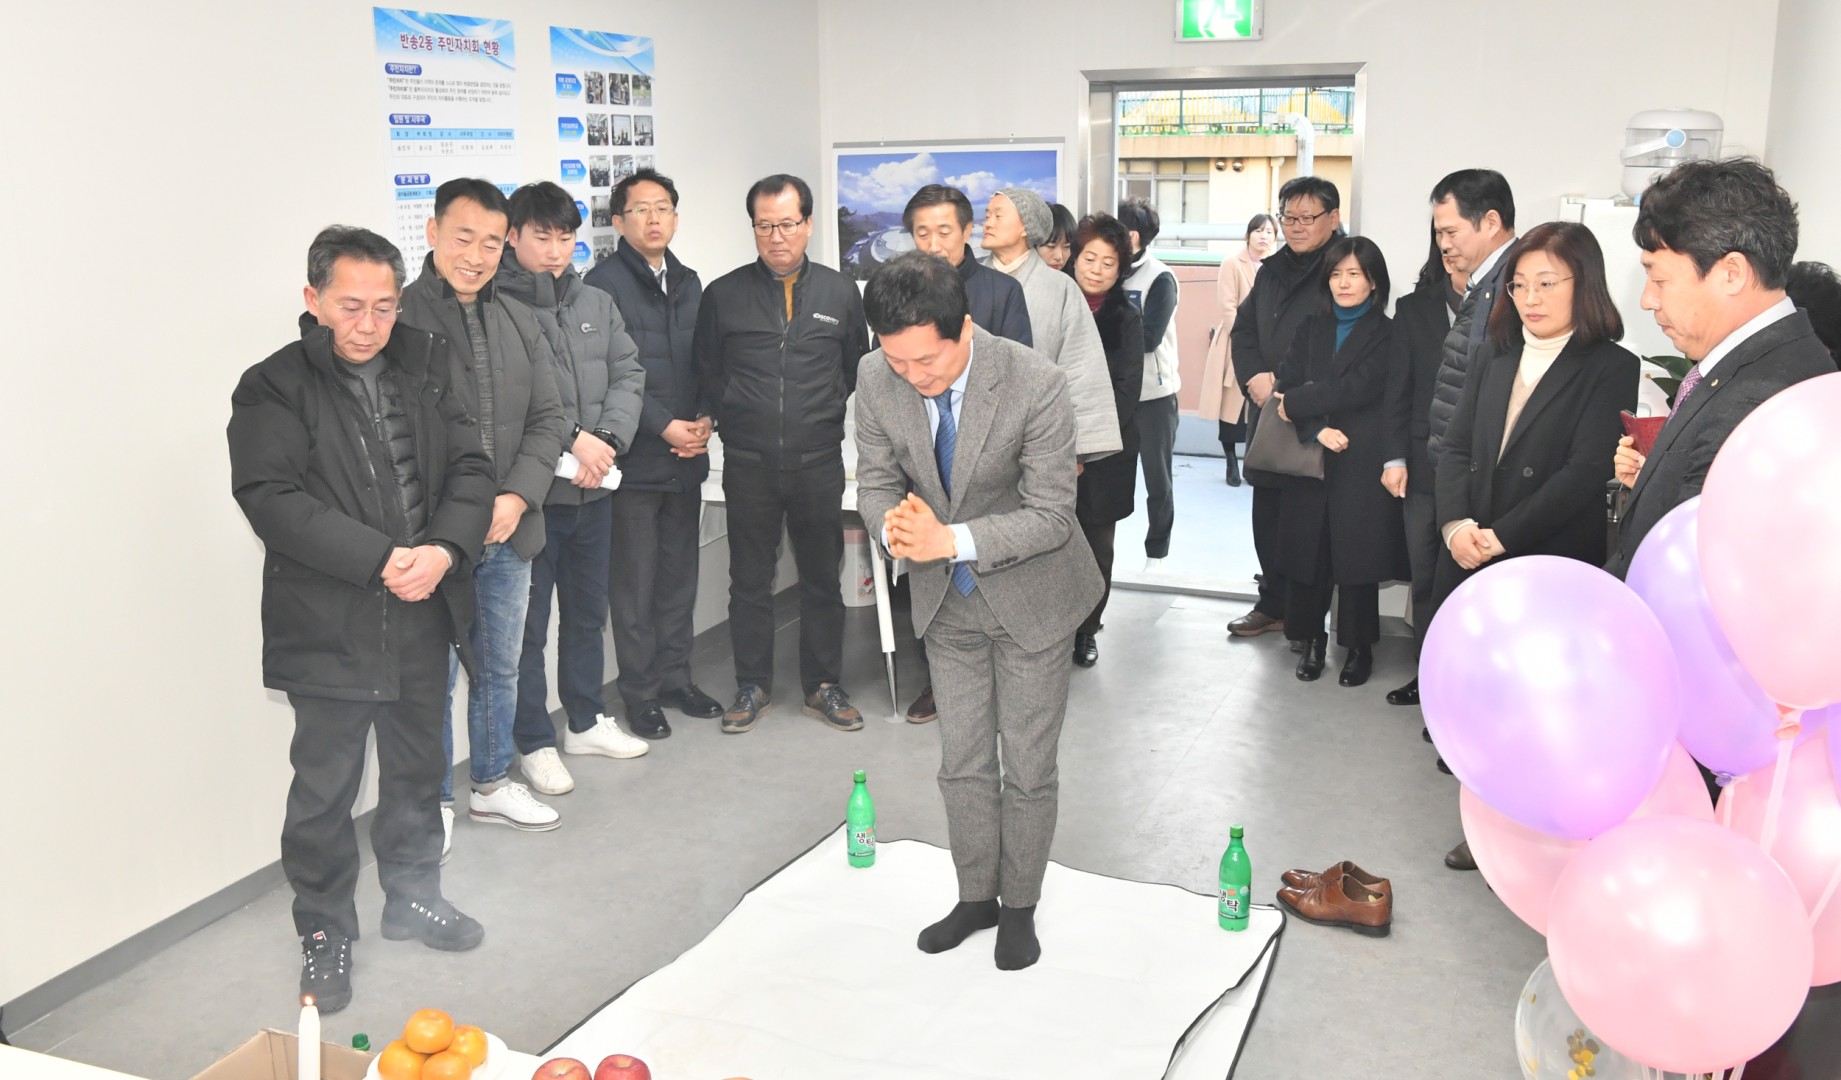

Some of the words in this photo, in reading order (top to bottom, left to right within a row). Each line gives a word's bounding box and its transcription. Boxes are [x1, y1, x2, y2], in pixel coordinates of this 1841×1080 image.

[400, 33, 433, 51] 반송2동
[437, 36, 480, 53] 주민자치회
[483, 40, 499, 56] 현황
